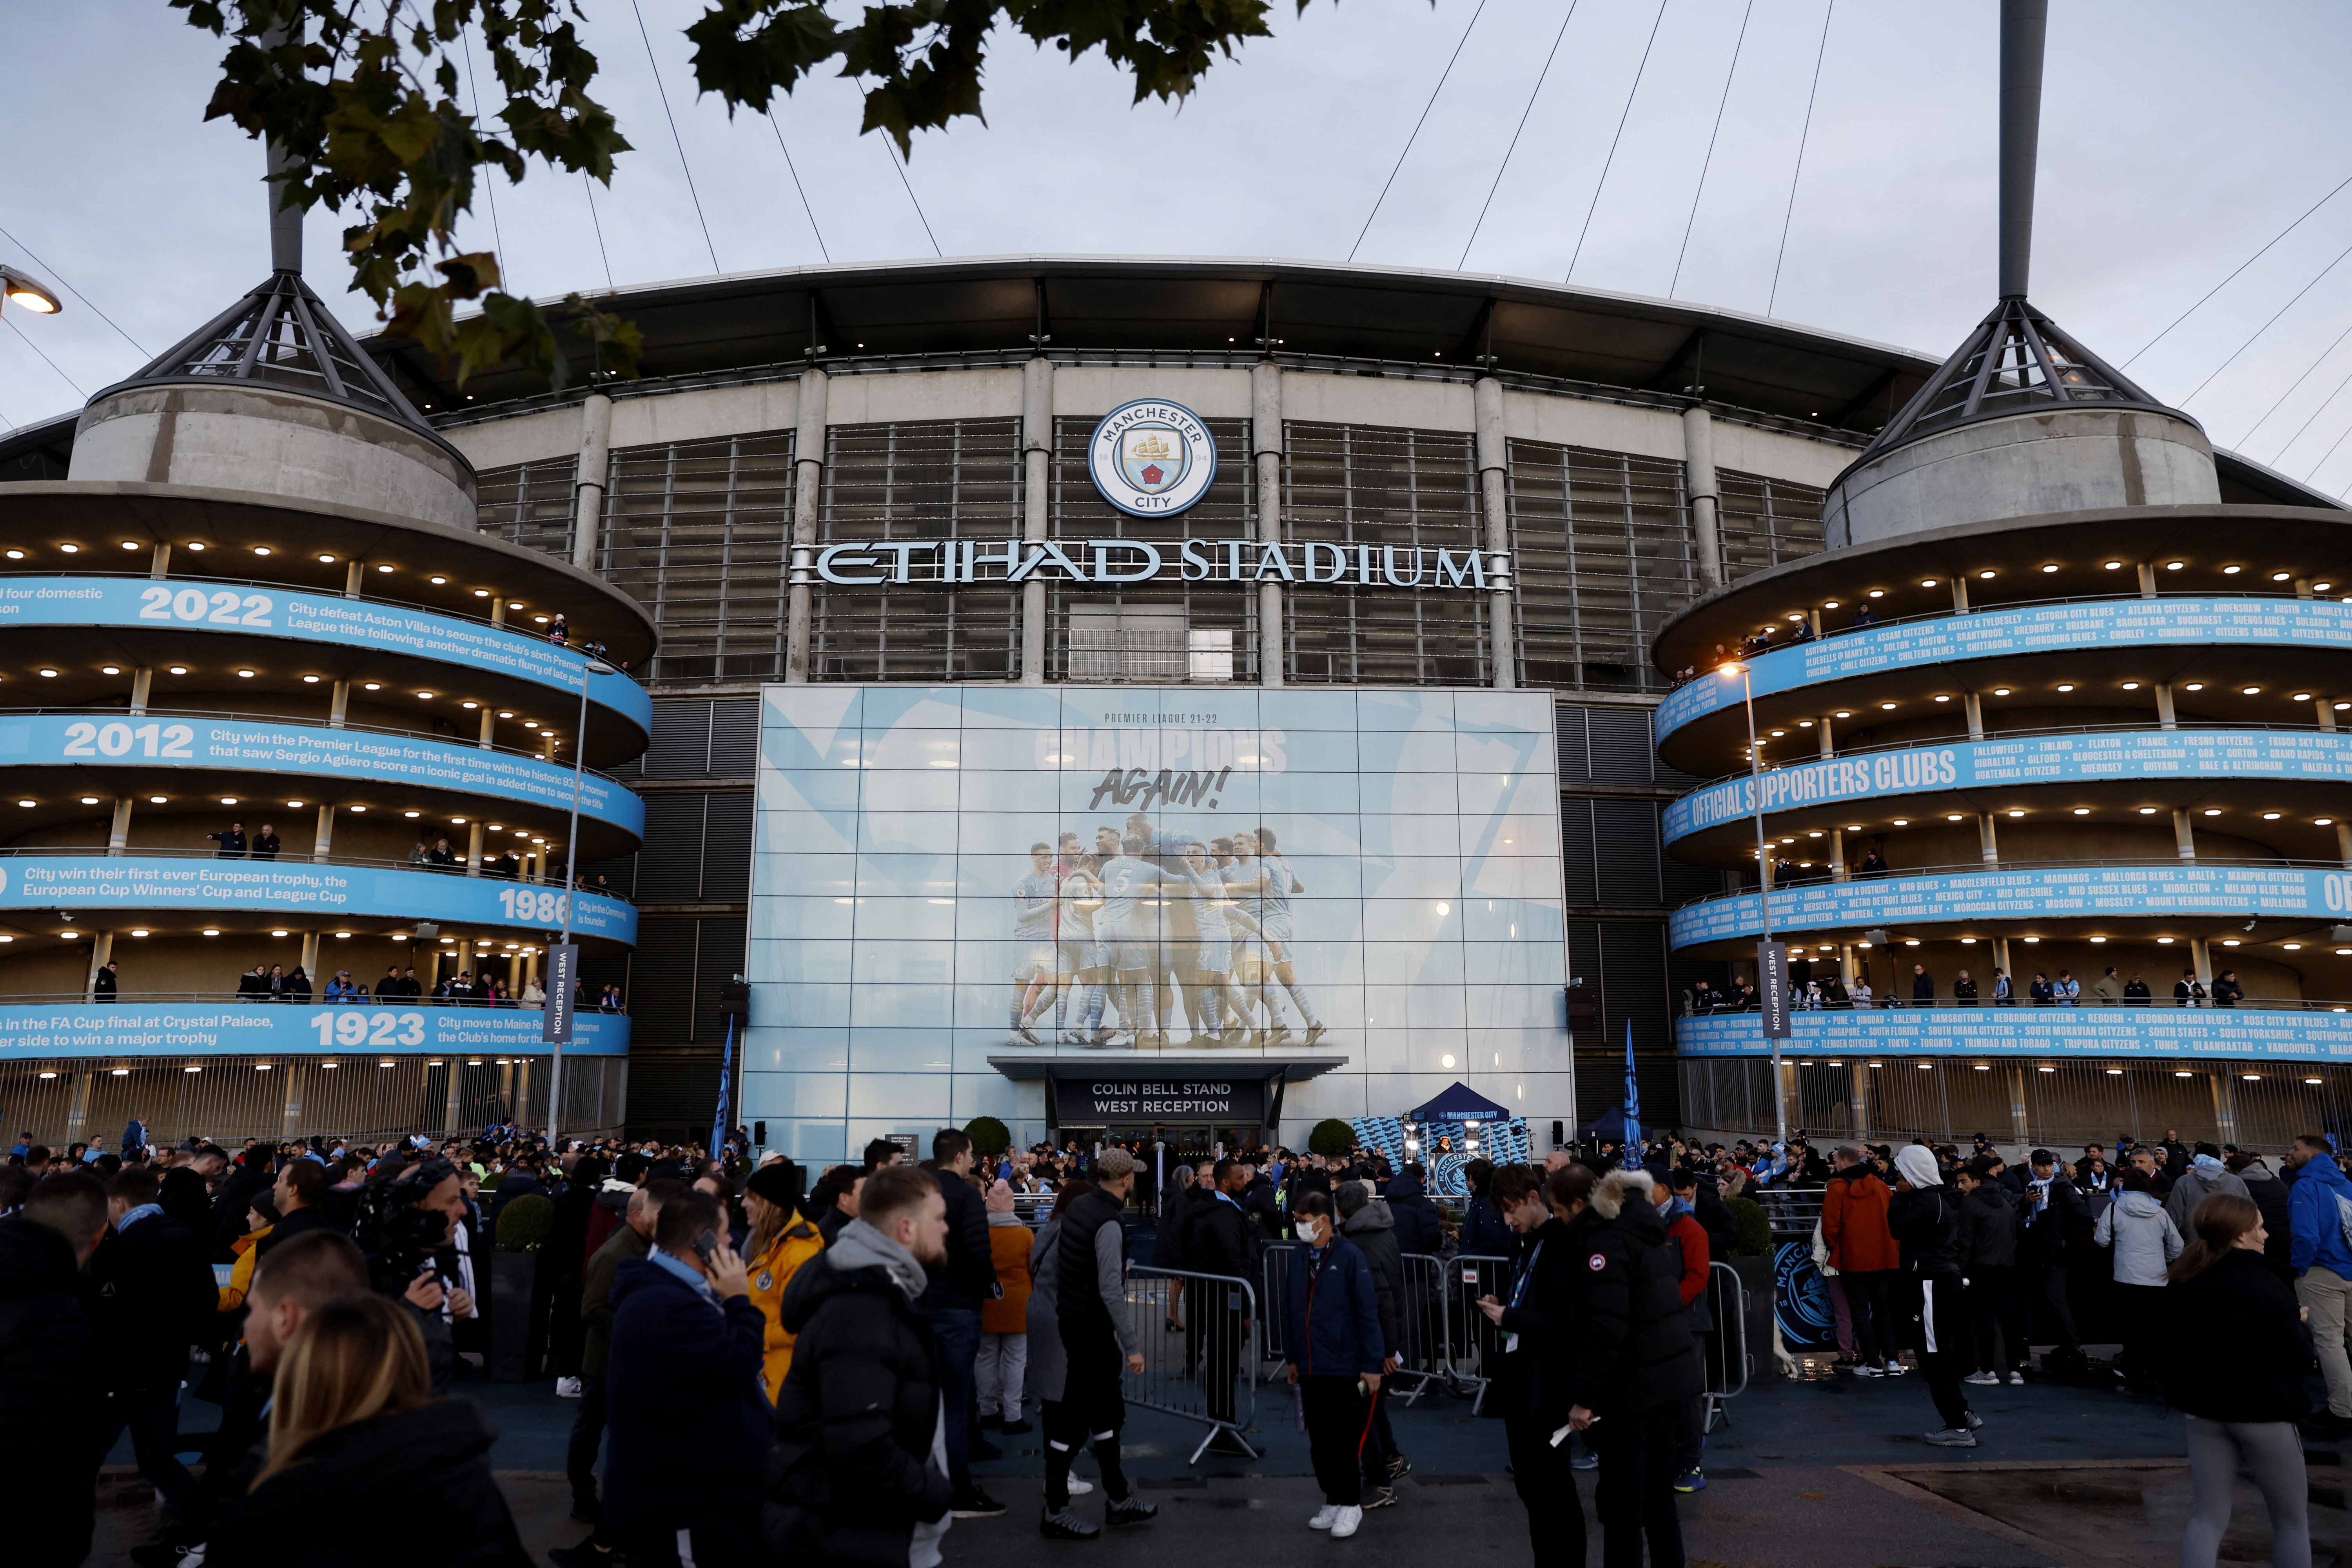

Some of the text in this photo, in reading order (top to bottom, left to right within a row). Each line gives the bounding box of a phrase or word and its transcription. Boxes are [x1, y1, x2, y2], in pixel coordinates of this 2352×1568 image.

[1103, 408, 1202, 443] MANCHESTER
[1135, 497, 1171, 508] CITY
[816, 539, 1486, 588] ETIHAD STADIUM
[139, 586, 273, 627] 2022
[289, 602, 583, 672] City defeat Aston Villa to secure the club's sixth Premier
[1806, 636, 1866, 656] ASHTON-UNDER-LYNE
[1877, 630, 1901, 642] ASSAM
[1903, 625, 1935, 637] CITYZENS
[1947, 620, 1973, 631] ASTLEY
[1975, 619, 1980, 628] &
[1982, 614, 2022, 627] TYLDESLEY
[2036, 610, 2069, 621] ASTORIA
[2070, 609, 2087, 619] CITY
[2090, 607, 2114, 617] BLUES
[2128, 605, 2162, 615] ATLANTA
[2164, 604, 2201, 613] CITYZENS
[2214, 604, 2261, 613] AUDENSHAW
[2274, 604, 2300, 614] AUSTIN
[2312, 606, 2342, 616] BAGULEY
[2344, 608, 2349, 617] &
[288, 616, 337, 632] League
[339, 624, 365, 636] title
[368, 627, 424, 648] following
[426, 640, 470, 655] another
[472, 648, 517, 666] dramatic
[518, 658, 543, 675] flurry
[544, 667, 553, 675] of
[553, 668, 568, 681] late
[1105, 713, 1147, 723] PREMIER
[1191, 714, 1217, 723] 21-22
[63, 722, 194, 759] 2012
[211, 730, 562, 785] City win the Premier League for the first time with the historic
[1035, 725, 1286, 775] CHAMPIONS
[1974, 744, 2024, 756] FALLOWFIELD
[2040, 740, 2073, 751] FINLAND
[2089, 739, 2121, 748] FLIXTON
[2137, 737, 2168, 746] FRANCE
[2184, 736, 2214, 746] FRESNO
[2217, 736, 2254, 746] CITYZENS
[2269, 737, 2296, 746] FRISCO
[2299, 738, 2313, 747] SKY
[2316, 738, 2339, 748] BLUES
[1089, 765, 1232, 811] AGAIN!
[1693, 790, 1744, 826] OFFICIAL
[1746, 760, 1870, 810] SUPPORTERS
[1875, 750, 1956, 789] CLUBS
[24, 884, 347, 904] European Cup Winners' Cup and League Cup
[25, 867, 347, 888] City win their first ever European trophy, the
[1804, 884, 2306, 911] MERSEYSIDE METRO DETROIT BLUES MEXICO CITY MID CHESHIRE MID SUSSEX BLUES MIDDLETON MILANO BLUE MOON
[554, 953, 567, 1034] WEST RECEPTION
[1768, 950, 1780, 1030] WEST RECEPTION
[6, 1018, 19, 1030] in
[22, 1018, 47, 1029] the
[51, 1017, 71, 1029] FA
[74, 1017, 105, 1031] Cup
[108, 1016, 141, 1028] final
[144, 1016, 160, 1027] at
[163, 1015, 218, 1029] Crystal
[221, 1015, 273, 1028] Palace,
[310, 1012, 425, 1046] 1923
[438, 1016, 532, 1030] City move to Maine
[1821, 1038, 2316, 1054] TLEMCEN CITYZENS TOKYO TORONTO TRINIDAD AND TOBAGO TRIPURA CITYZENS TUNIS ULAANBAATAR VANCOUVER
[1093, 1083, 1231, 1095] COLIN BELL STAND
[1094, 1101, 1229, 1112] WEST RECEPTION
